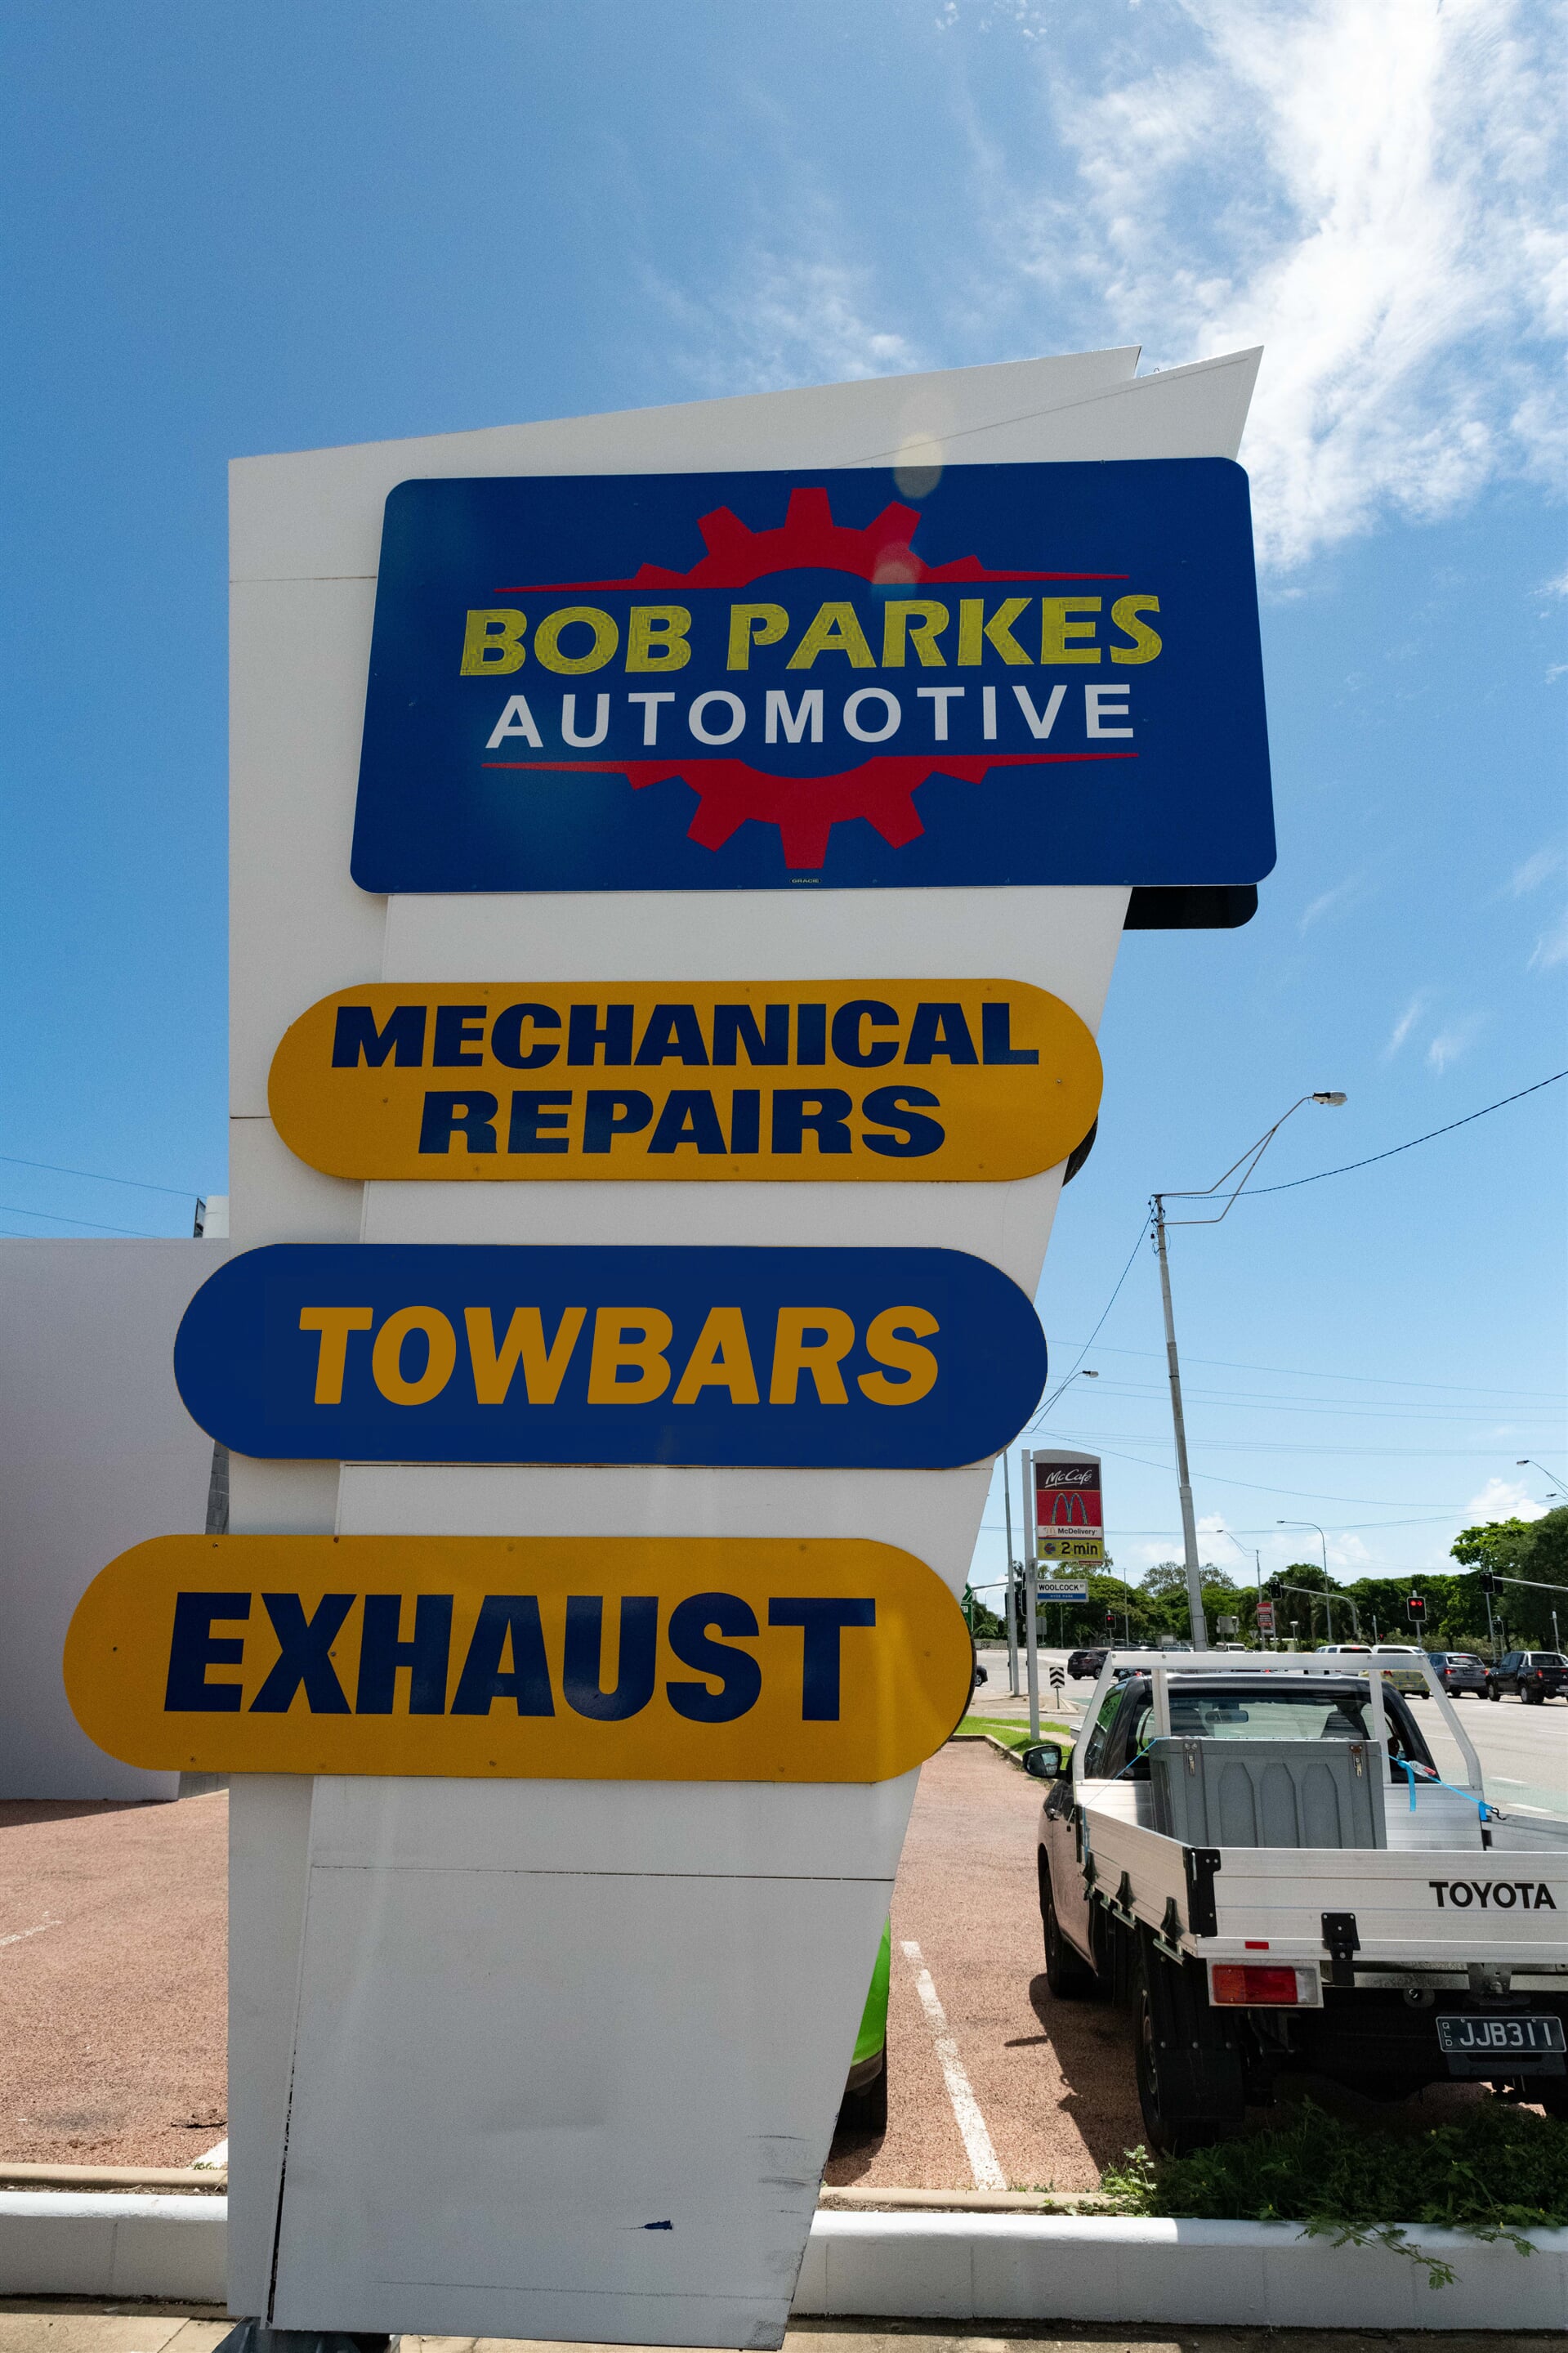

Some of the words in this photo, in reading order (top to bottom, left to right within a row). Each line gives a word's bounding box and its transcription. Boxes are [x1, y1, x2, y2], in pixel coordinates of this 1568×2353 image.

[460, 605, 692, 676] BOB
[726, 594, 1164, 671] PARKES
[485, 684, 1134, 749] AUTOMOTIVE
[332, 1000, 1039, 1069] MECHANICAL
[418, 1085, 945, 1157] REPAIRS
[298, 1305, 940, 1407] TOWBARS
[1057, 1528, 1096, 1536] McDelivery
[1061, 1541, 1070, 1555] 2
[1074, 1542, 1098, 1555] min
[163, 1591, 877, 1724] EXHAUST
[1429, 1881, 1557, 1910] TOYOTA
[1442, 2022, 1453, 2047] QLD
[1459, 2022, 1552, 2047] JJB311
